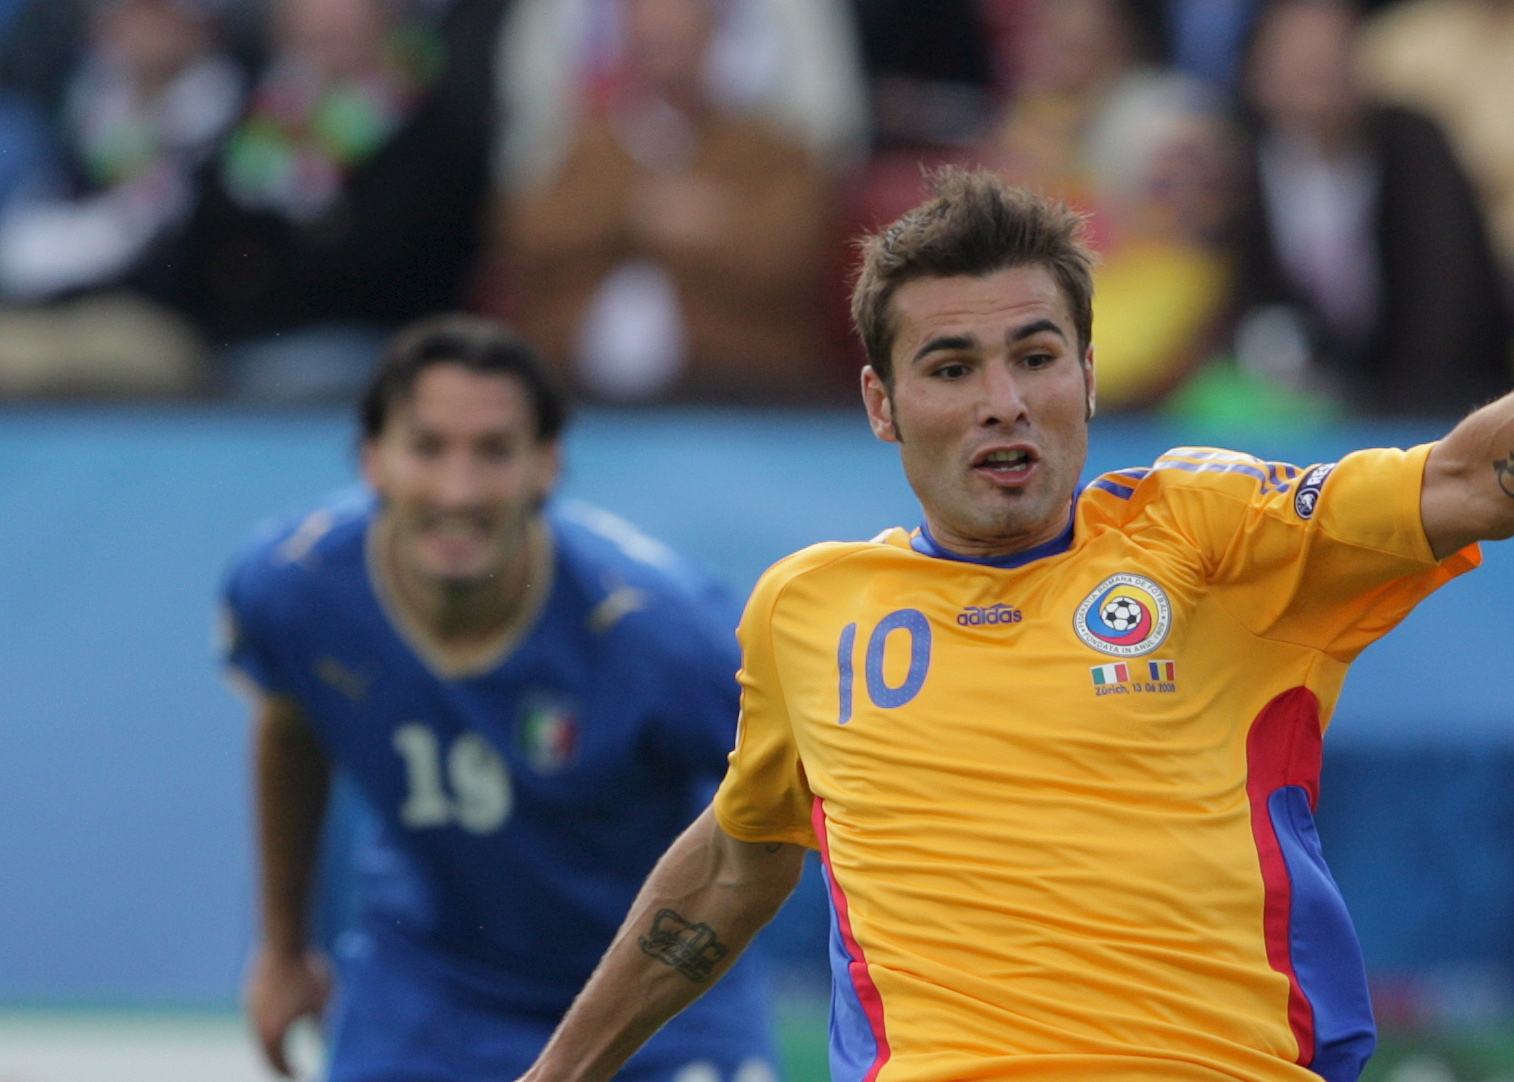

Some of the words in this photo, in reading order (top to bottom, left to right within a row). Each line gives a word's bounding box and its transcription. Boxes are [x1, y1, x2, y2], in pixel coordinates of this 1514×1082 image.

[837, 608, 933, 725] 10
[957, 603, 1022, 626] adidas
[394, 722, 512, 835] 19
